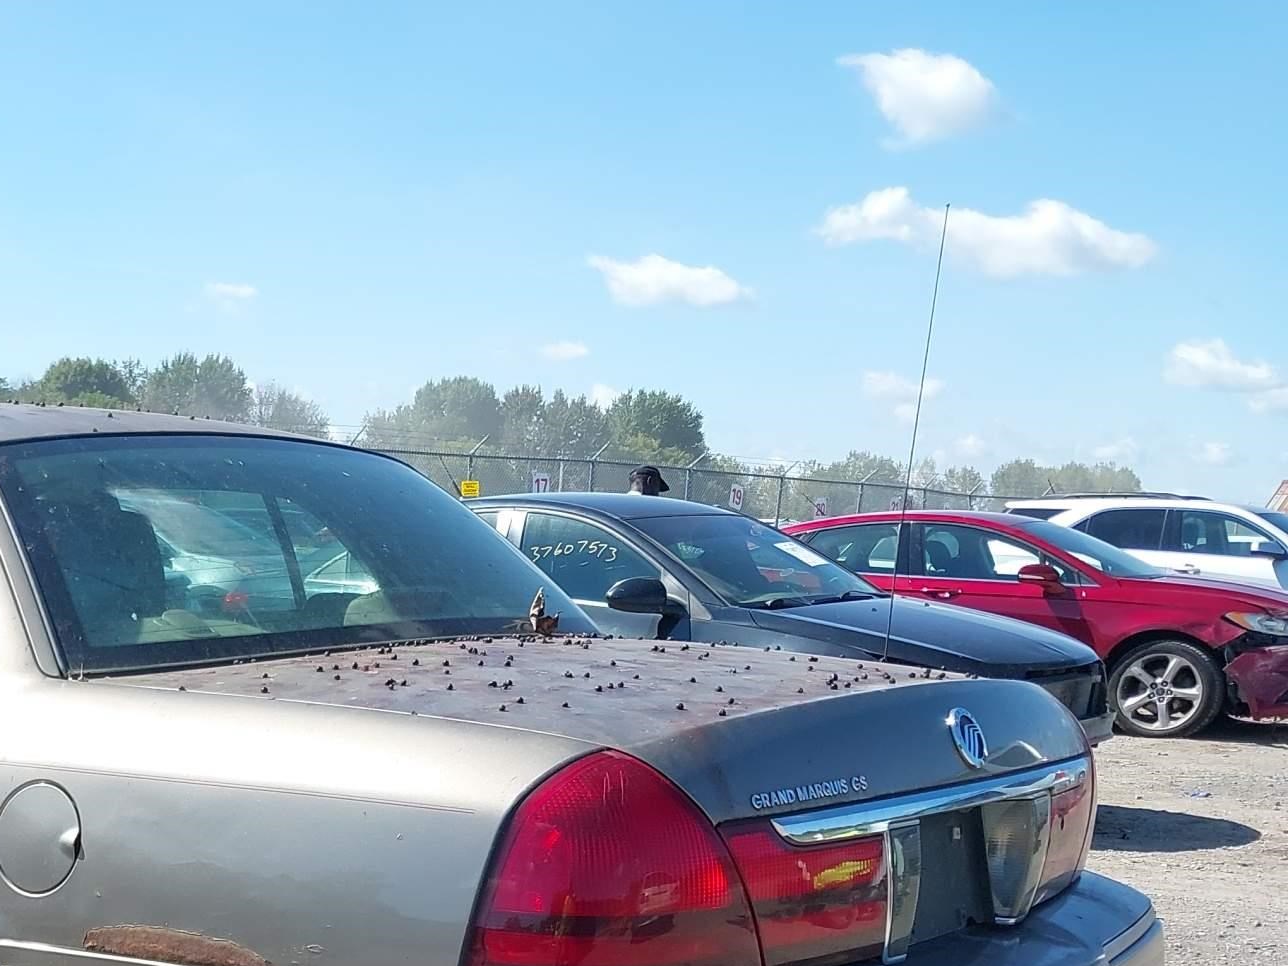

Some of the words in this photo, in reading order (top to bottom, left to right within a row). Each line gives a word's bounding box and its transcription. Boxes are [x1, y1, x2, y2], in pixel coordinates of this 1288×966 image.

[534, 478, 548, 493] 17
[732, 488, 742, 506] 19
[751, 789, 795, 809] GRAND
[795, 779, 849, 802] MARQUIS
[851, 775, 868, 792] GS
